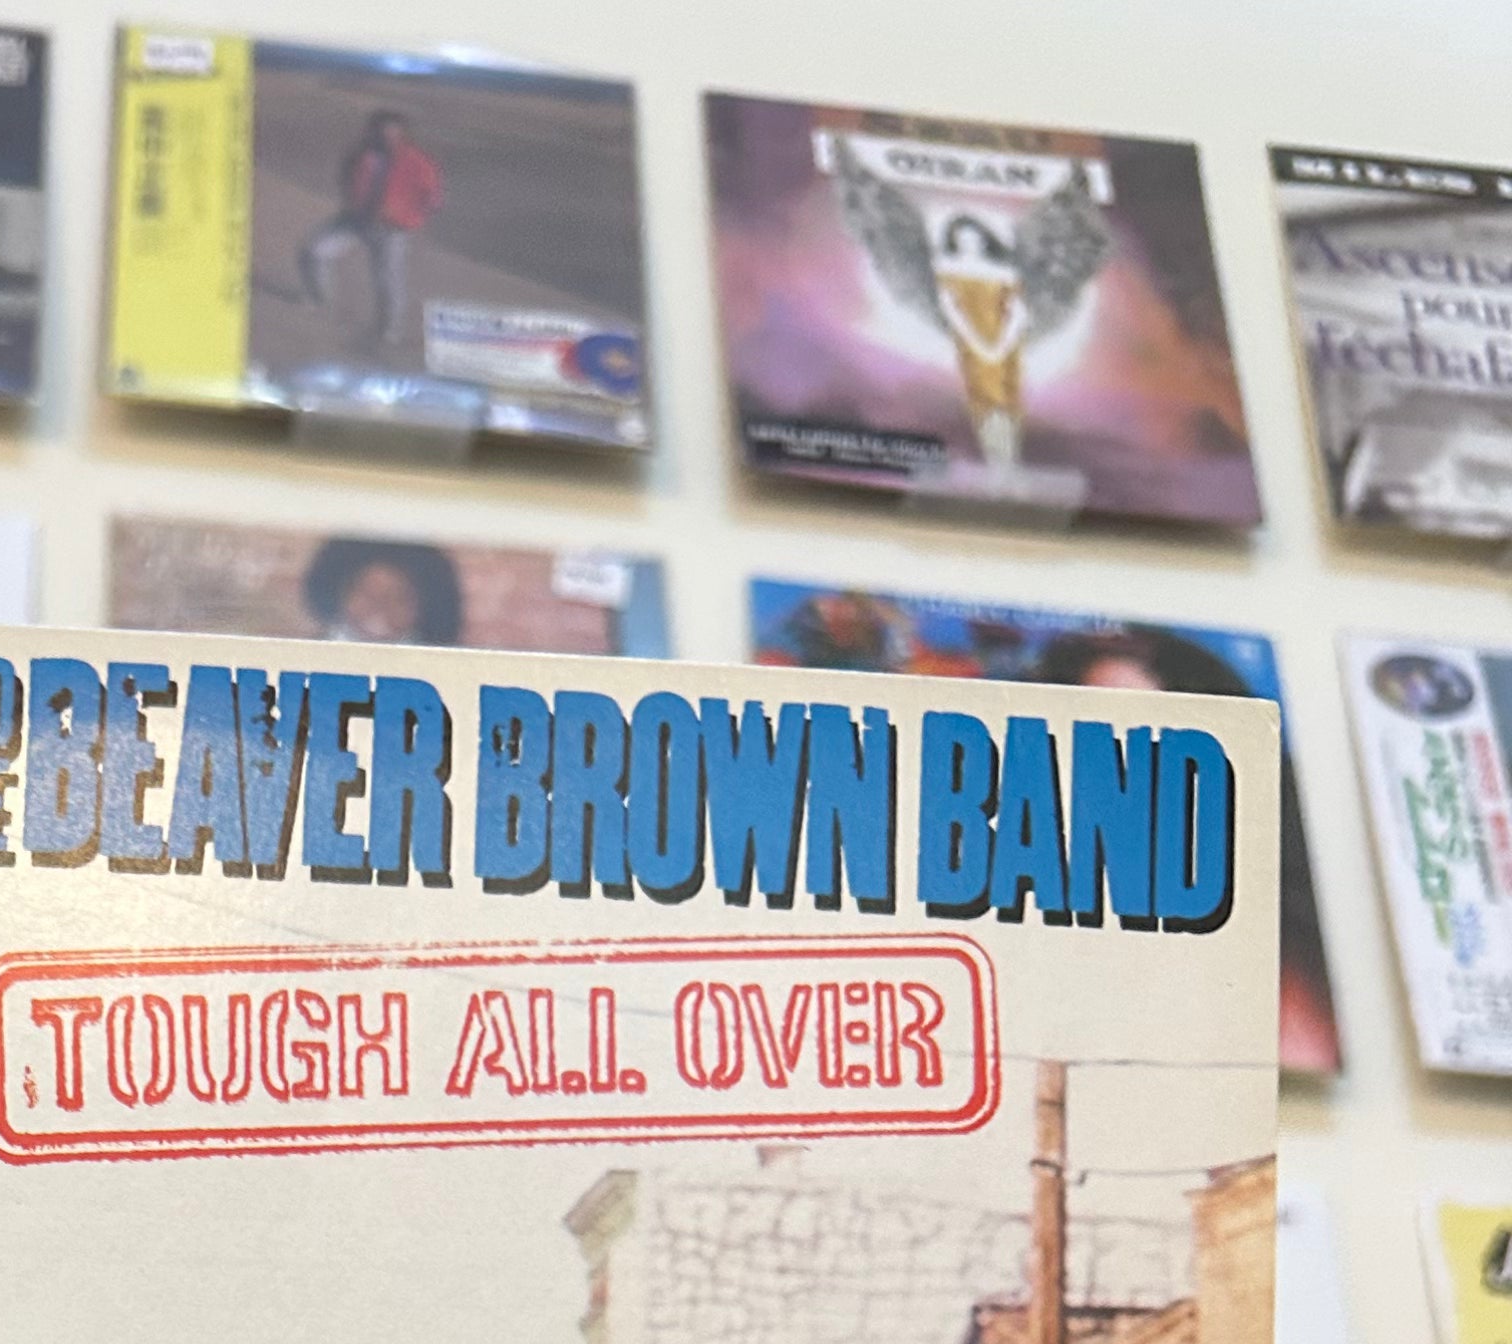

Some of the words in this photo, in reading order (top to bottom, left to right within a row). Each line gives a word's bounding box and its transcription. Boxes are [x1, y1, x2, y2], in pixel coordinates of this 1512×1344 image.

[23, 657, 454, 888] BEAVER
[474, 685, 897, 915] BROWN
[917, 710, 1236, 935] BAND
[31, 989, 410, 1112] TOUGH
[445, 986, 648, 1100] ALL
[675, 980, 944, 1090] OVER
